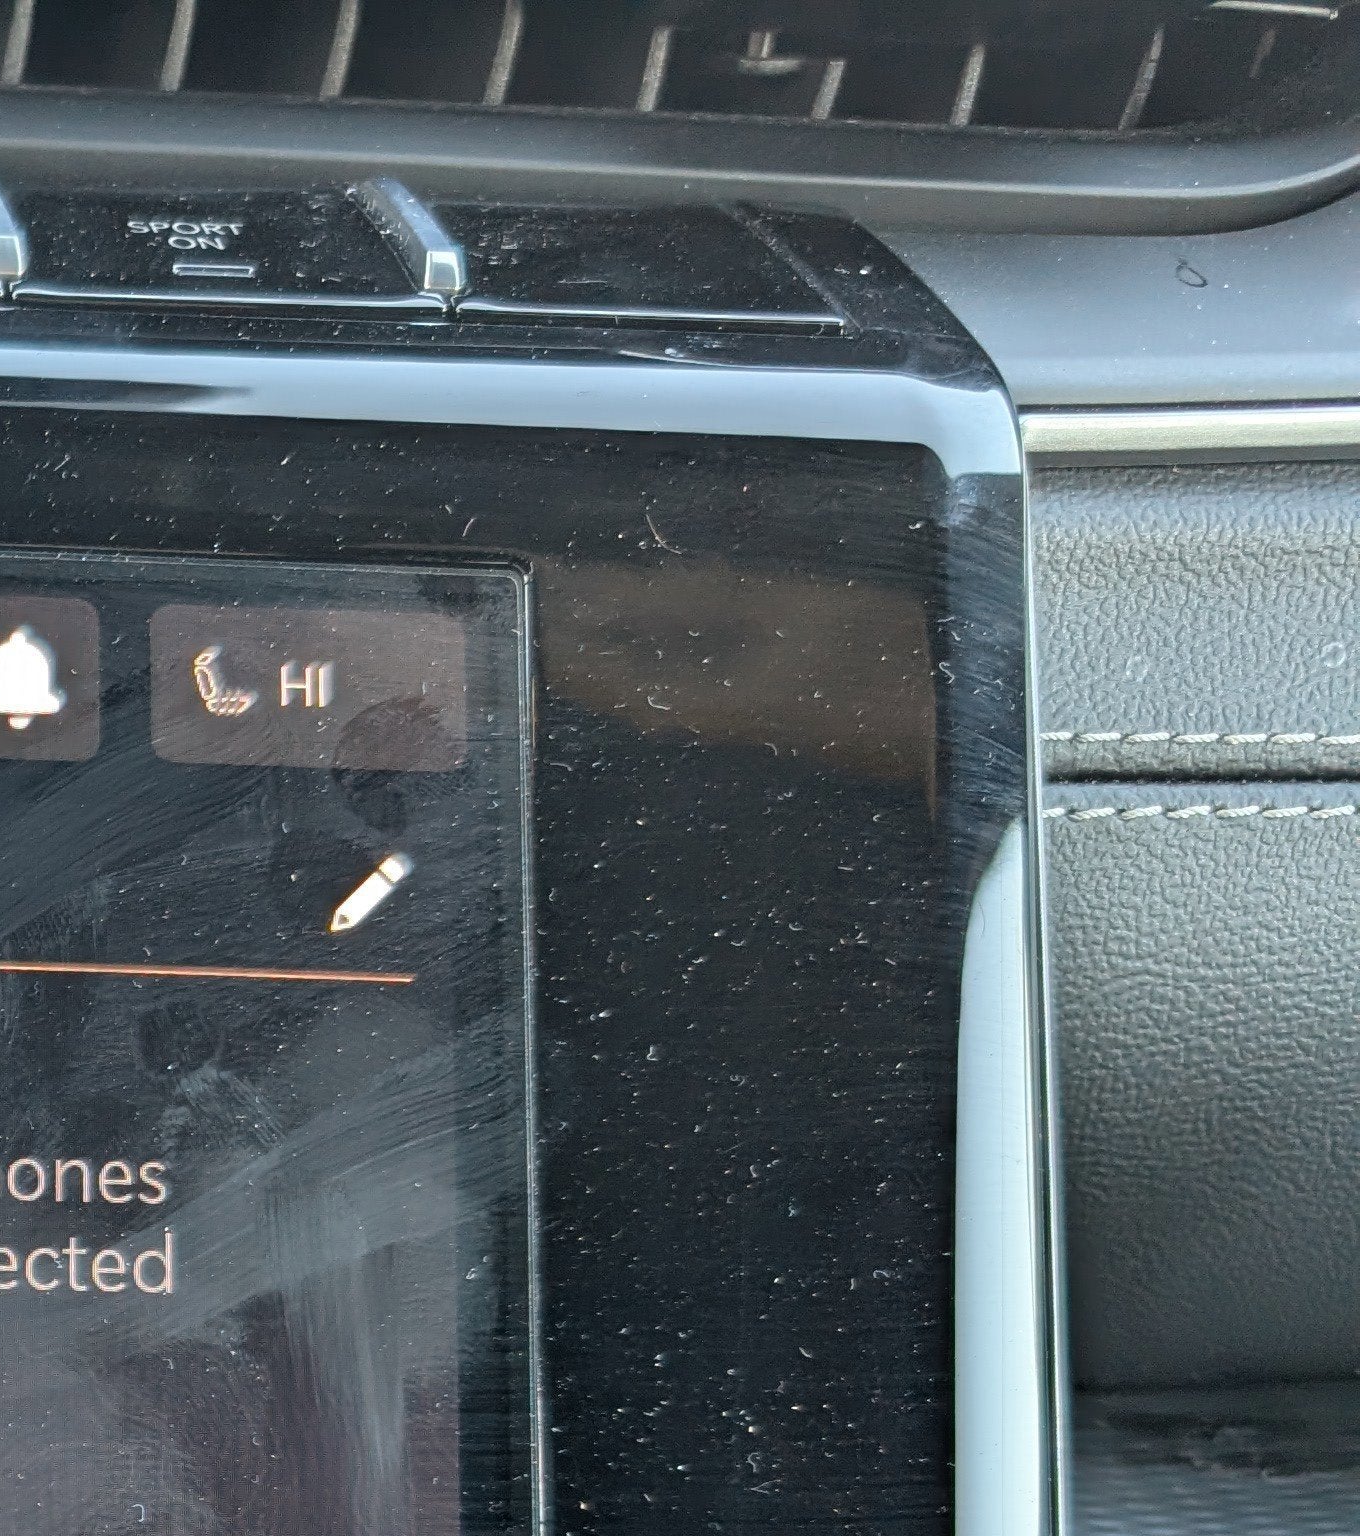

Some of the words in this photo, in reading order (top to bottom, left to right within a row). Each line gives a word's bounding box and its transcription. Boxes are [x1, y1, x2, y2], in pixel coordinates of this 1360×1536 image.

[127, 221, 243, 236] SPORT
[167, 236, 225, 250] ON
[279, 661, 332, 708] HI
